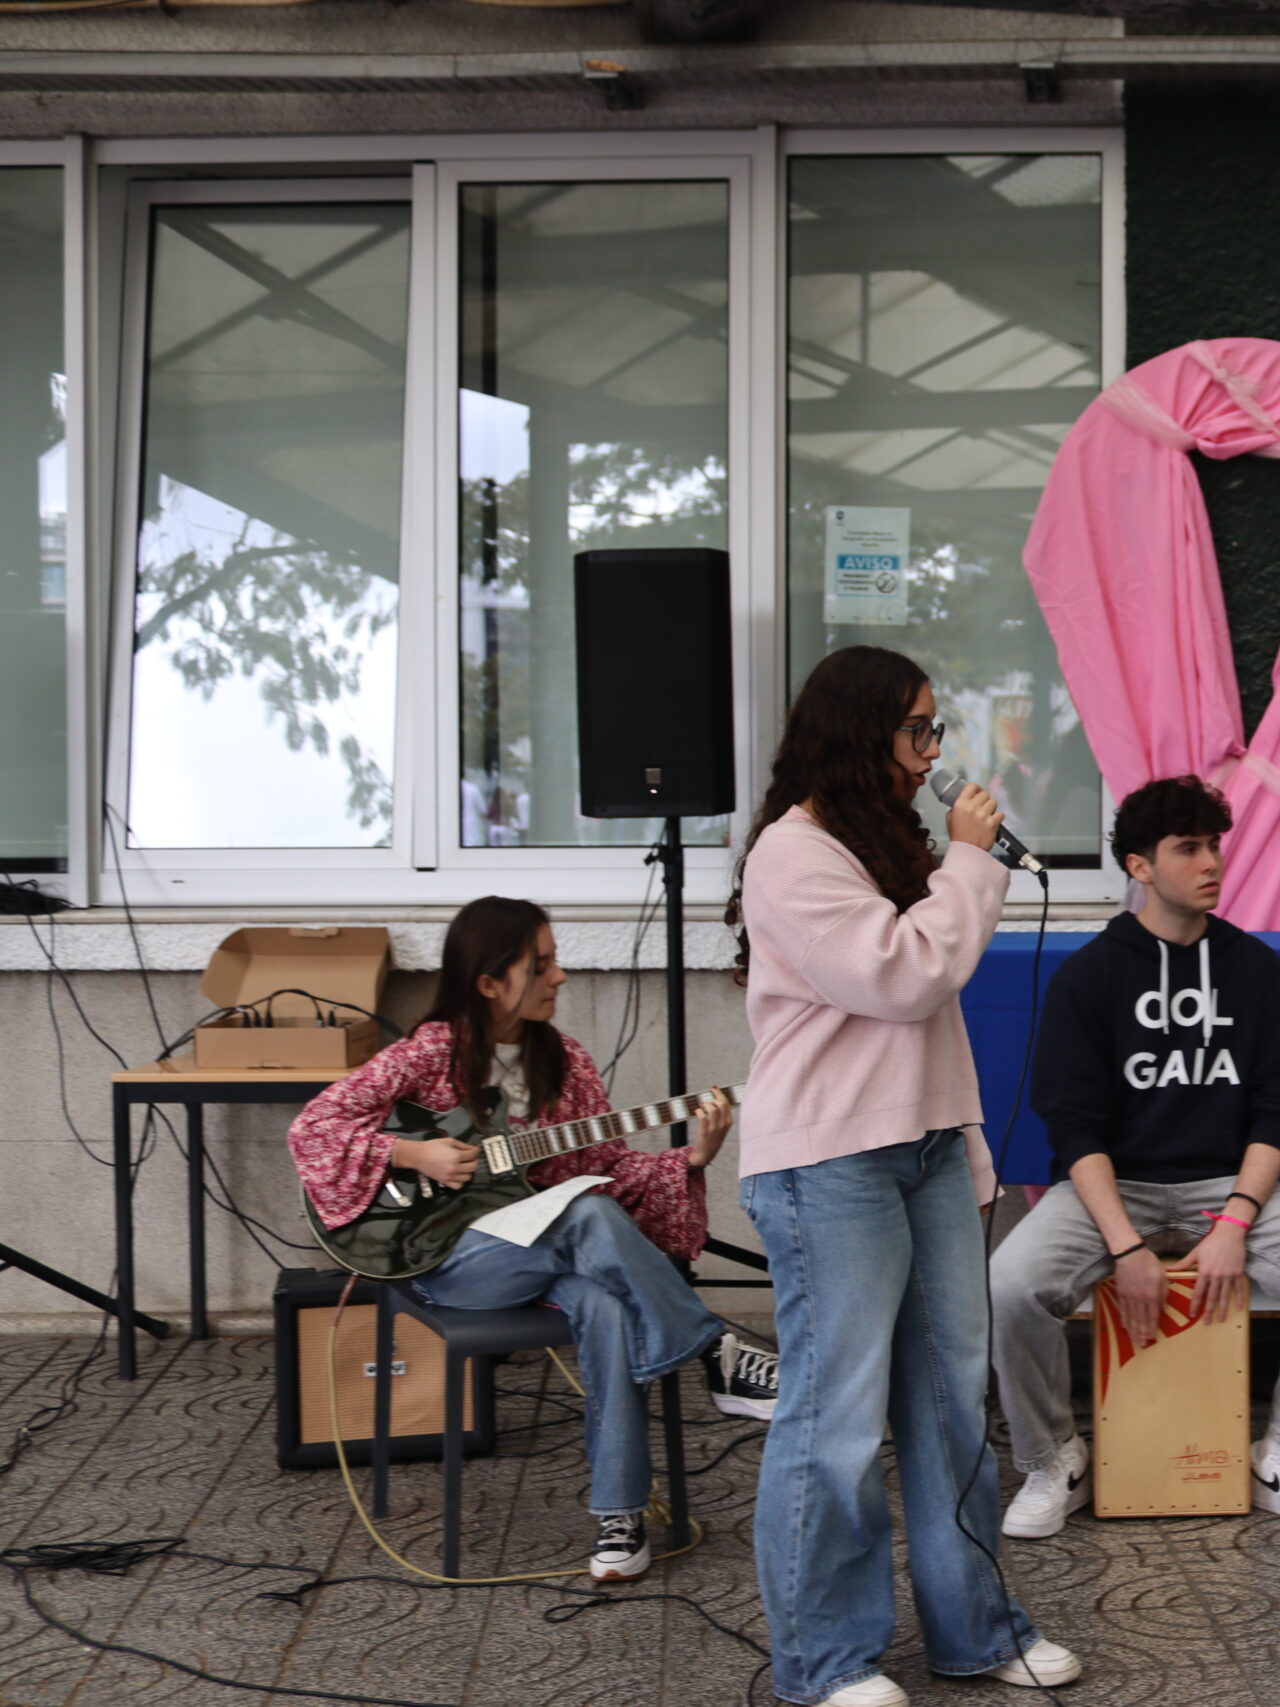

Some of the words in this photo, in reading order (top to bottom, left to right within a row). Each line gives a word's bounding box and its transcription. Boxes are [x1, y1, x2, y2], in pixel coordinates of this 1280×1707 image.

[844, 556, 894, 570] AVISO
[1134, 988, 1234, 1029] COL
[1123, 1048, 1241, 1090] GAIA
